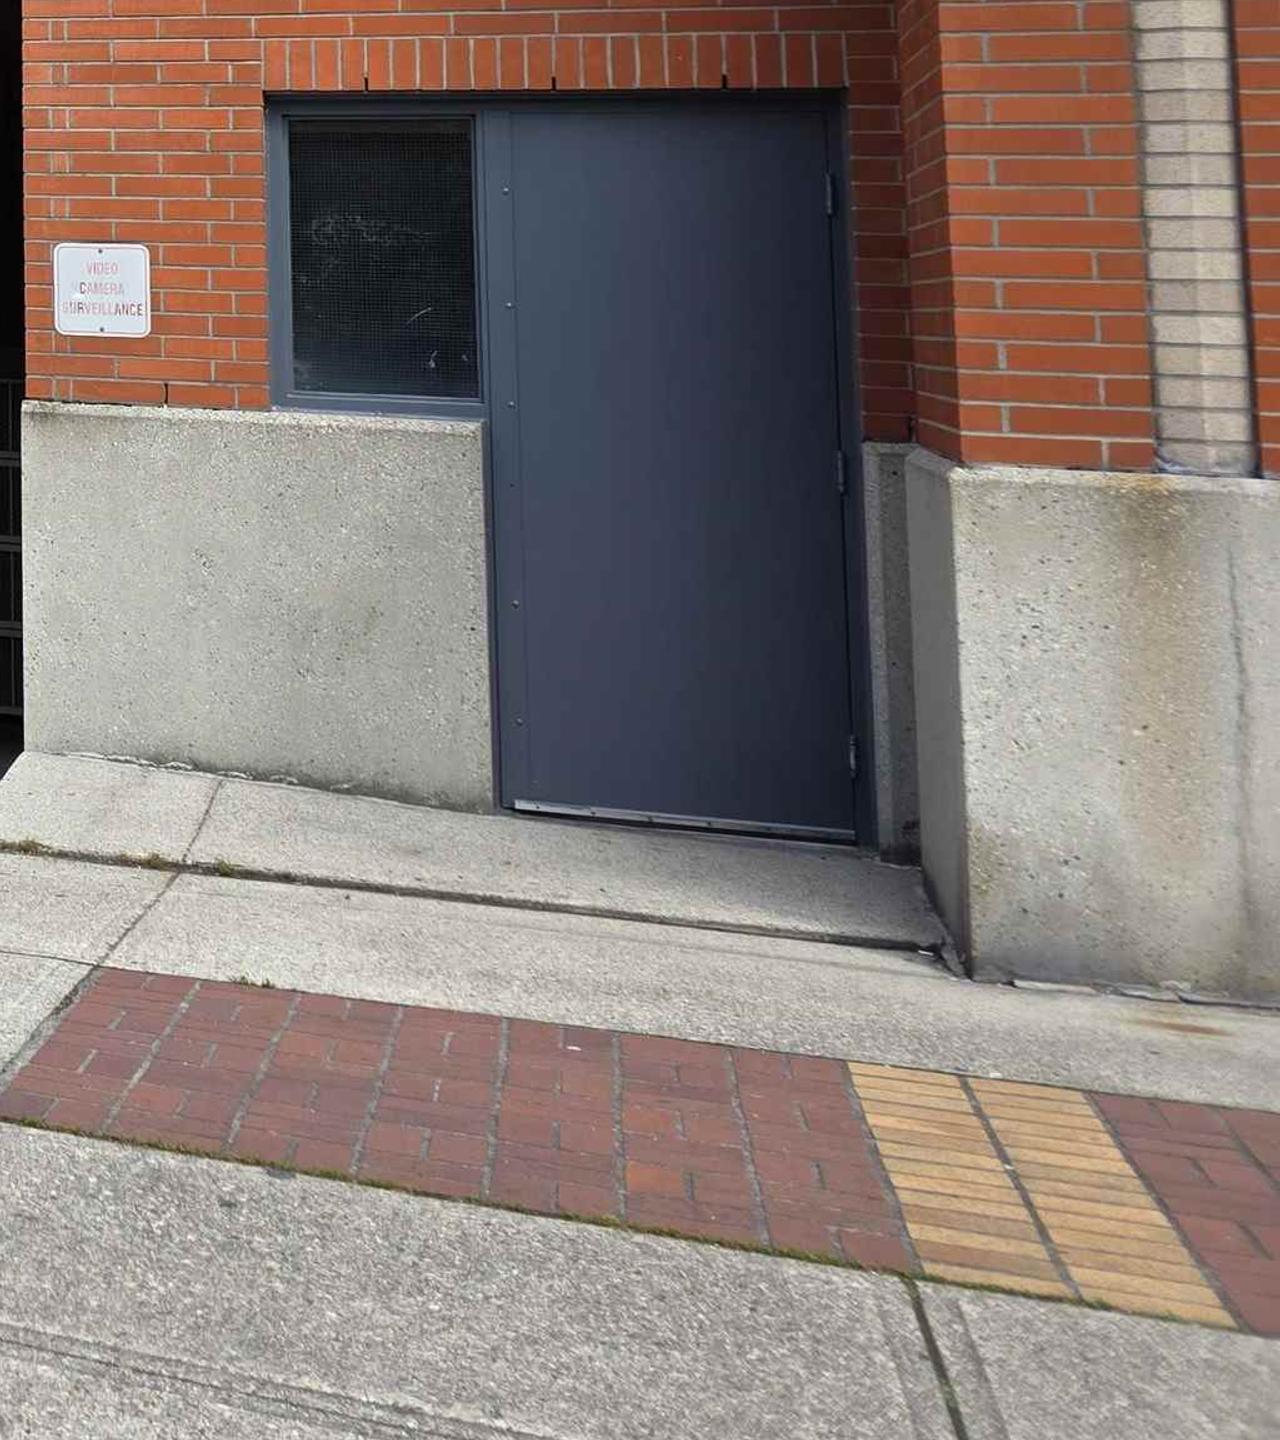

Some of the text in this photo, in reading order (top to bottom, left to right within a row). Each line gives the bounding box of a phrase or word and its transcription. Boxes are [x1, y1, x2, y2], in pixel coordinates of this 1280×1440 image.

[86, 262, 118, 275] VIDEO
[79, 282, 125, 295] CAMERA
[62, 301, 143, 317] SURVEILLANCE
